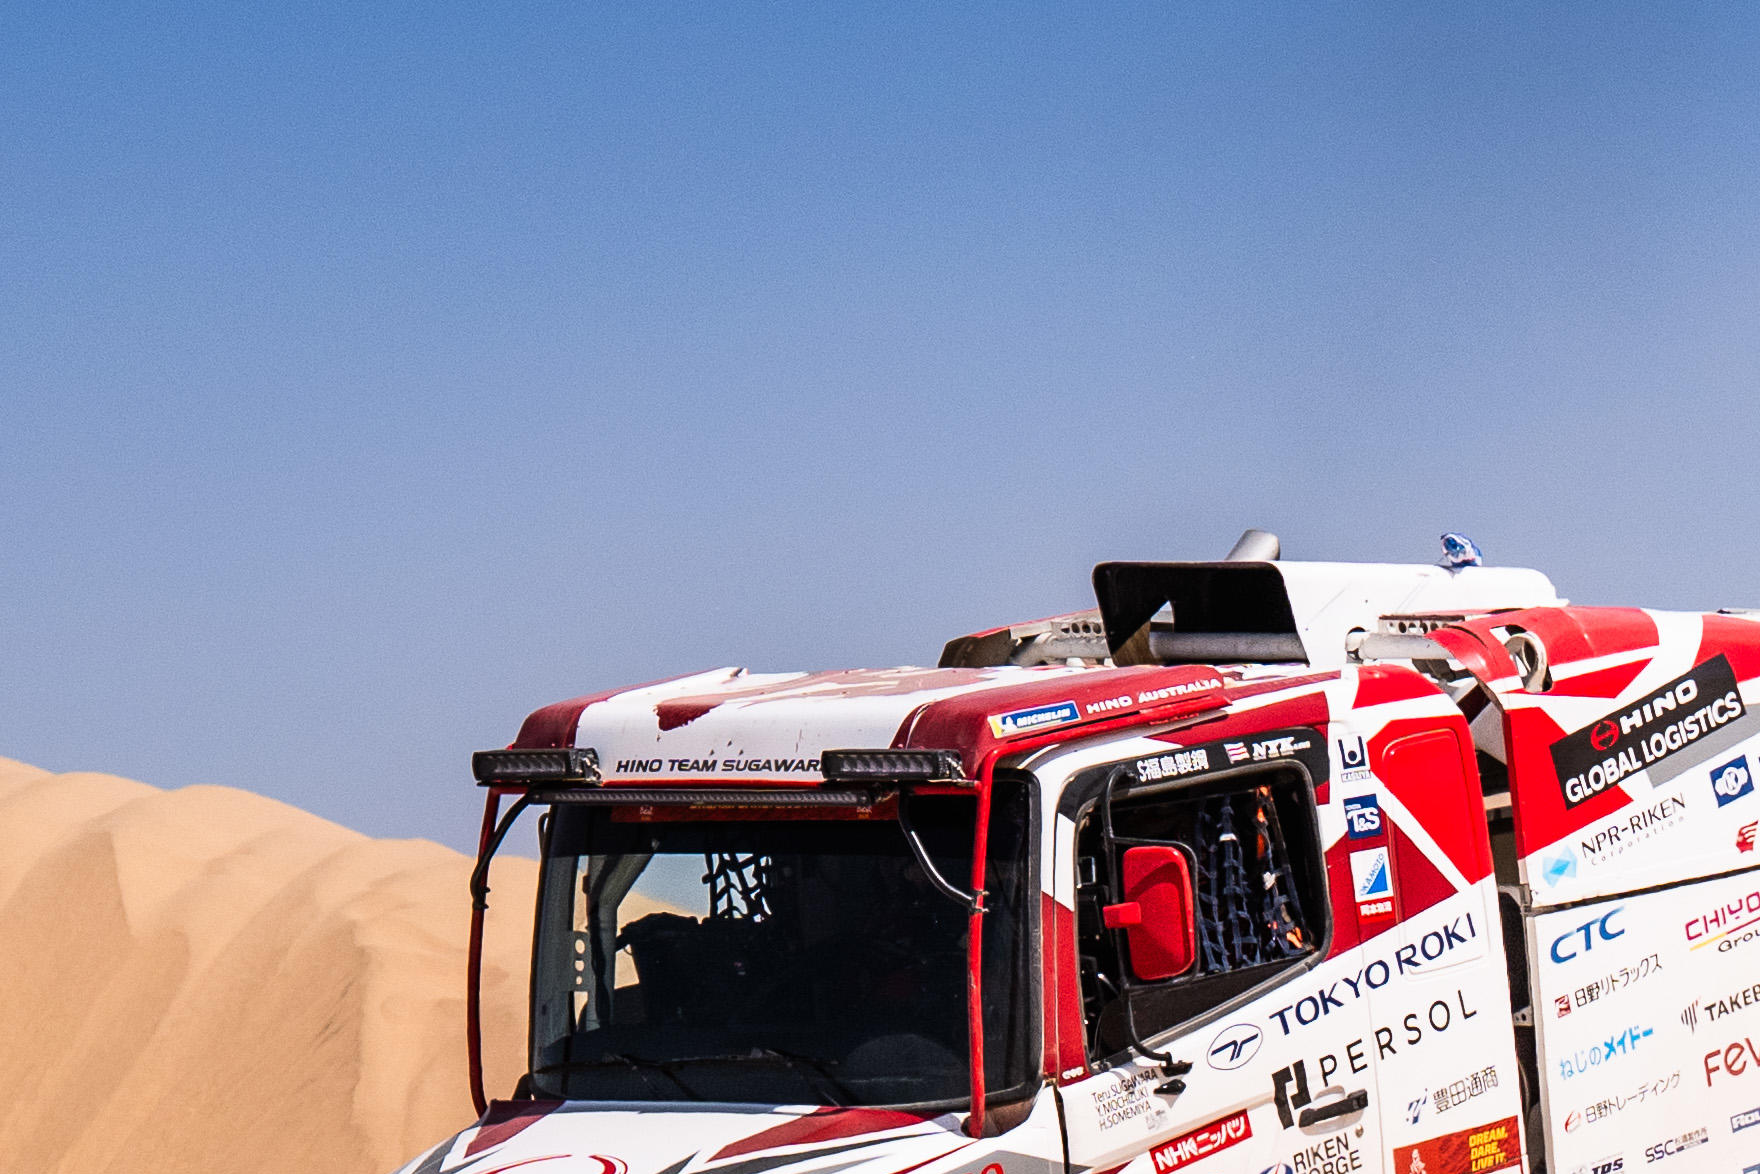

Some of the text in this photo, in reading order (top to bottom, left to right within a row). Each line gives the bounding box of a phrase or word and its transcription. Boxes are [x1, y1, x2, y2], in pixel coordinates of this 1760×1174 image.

[1016, 707, 1071, 727] MICHELIN
[1086, 678, 1222, 714] HINO AUSTRALIA
[1620, 677, 1698, 735] HINO
[616, 758, 823, 773] HINO TEAM SUGAWAR
[1565, 696, 1742, 804] GLOBAL LOGISTICS
[1580, 792, 1686, 856] NPR-RIKEN
[1589, 814, 1685, 867] Corporation
[1550, 905, 1625, 964] CTC
[1574, 953, 1663, 1008] 日野リトラックス
[1320, 989, 1477, 1087] PERSOL
[1560, 1025, 1654, 1081] ねじのメイドー
[1111, 1068, 1158, 1098] SUGAWARA
[1433, 1065, 1499, 1115] 豊田通商
[1585, 1069, 1681, 1124] 日野トレーディング
[1293, 1132, 1350, 1173] RIKEN
[1469, 1126, 1508, 1147] DREAM.
[1470, 1141, 1500, 1160] DARE.
[1645, 1139, 1675, 1163] SSC
[1472, 1155, 1494, 1172] LIVE
